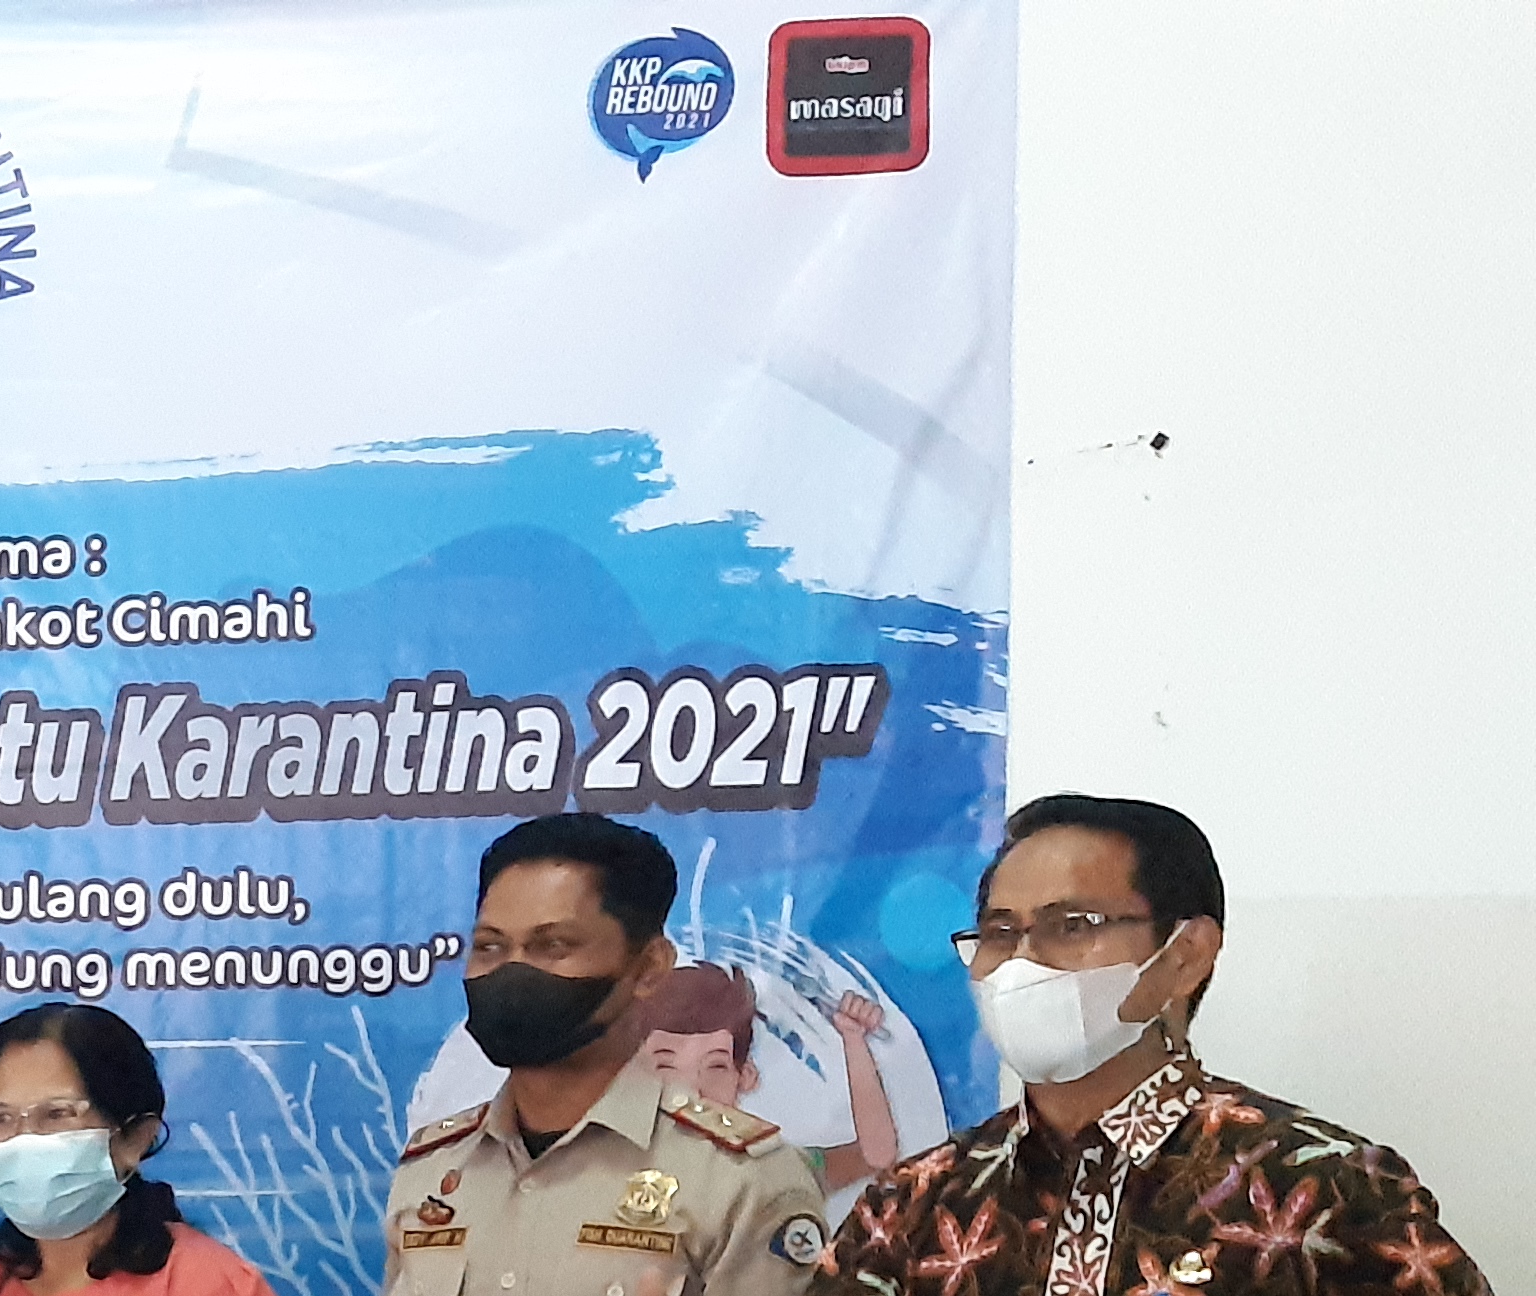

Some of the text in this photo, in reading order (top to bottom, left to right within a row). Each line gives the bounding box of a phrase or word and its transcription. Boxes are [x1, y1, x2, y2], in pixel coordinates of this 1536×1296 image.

[611, 56, 662, 86] KKP
[605, 82, 718, 115] REBOUND
[663, 113, 711, 130] 2021
[113, 590, 313, 643] Cimahi
[109, 682, 562, 802] Karantina
[583, 674, 877, 789] 2021"
[164, 871, 307, 923] dulu,
